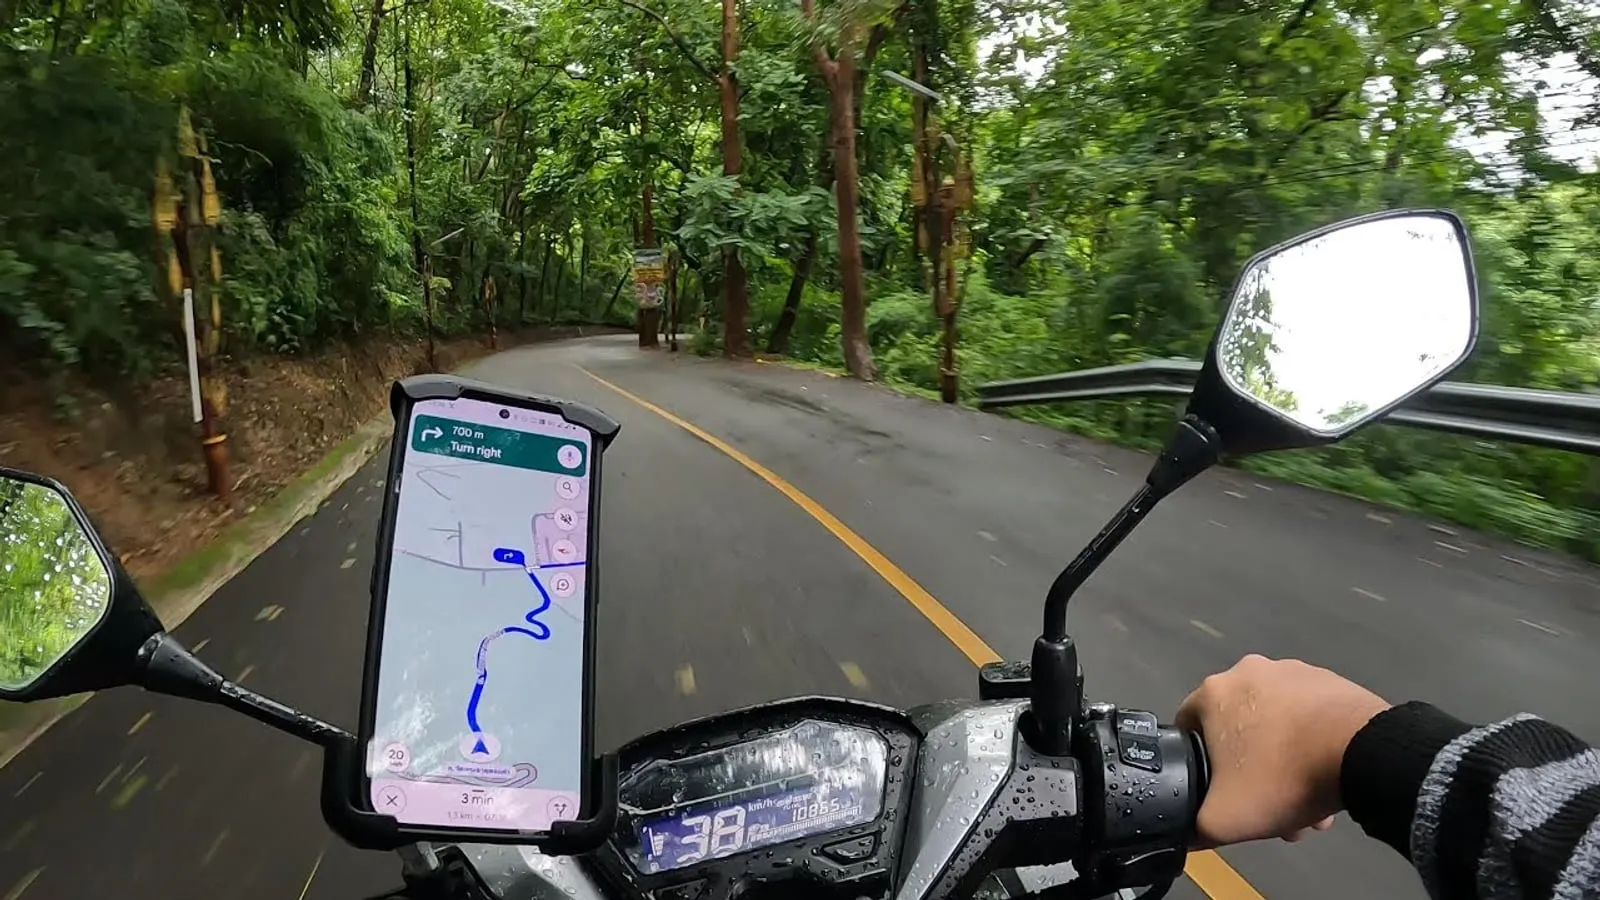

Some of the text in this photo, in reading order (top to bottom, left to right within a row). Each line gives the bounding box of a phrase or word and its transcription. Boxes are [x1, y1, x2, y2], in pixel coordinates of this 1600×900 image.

[451, 426, 484, 440] 700 m
[450, 441, 502, 459] Turn right
[388, 748, 404, 760] 20
[461, 792, 494, 806] 3 min
[748, 798, 774, 812] km/h
[676, 805, 747, 863] 38
